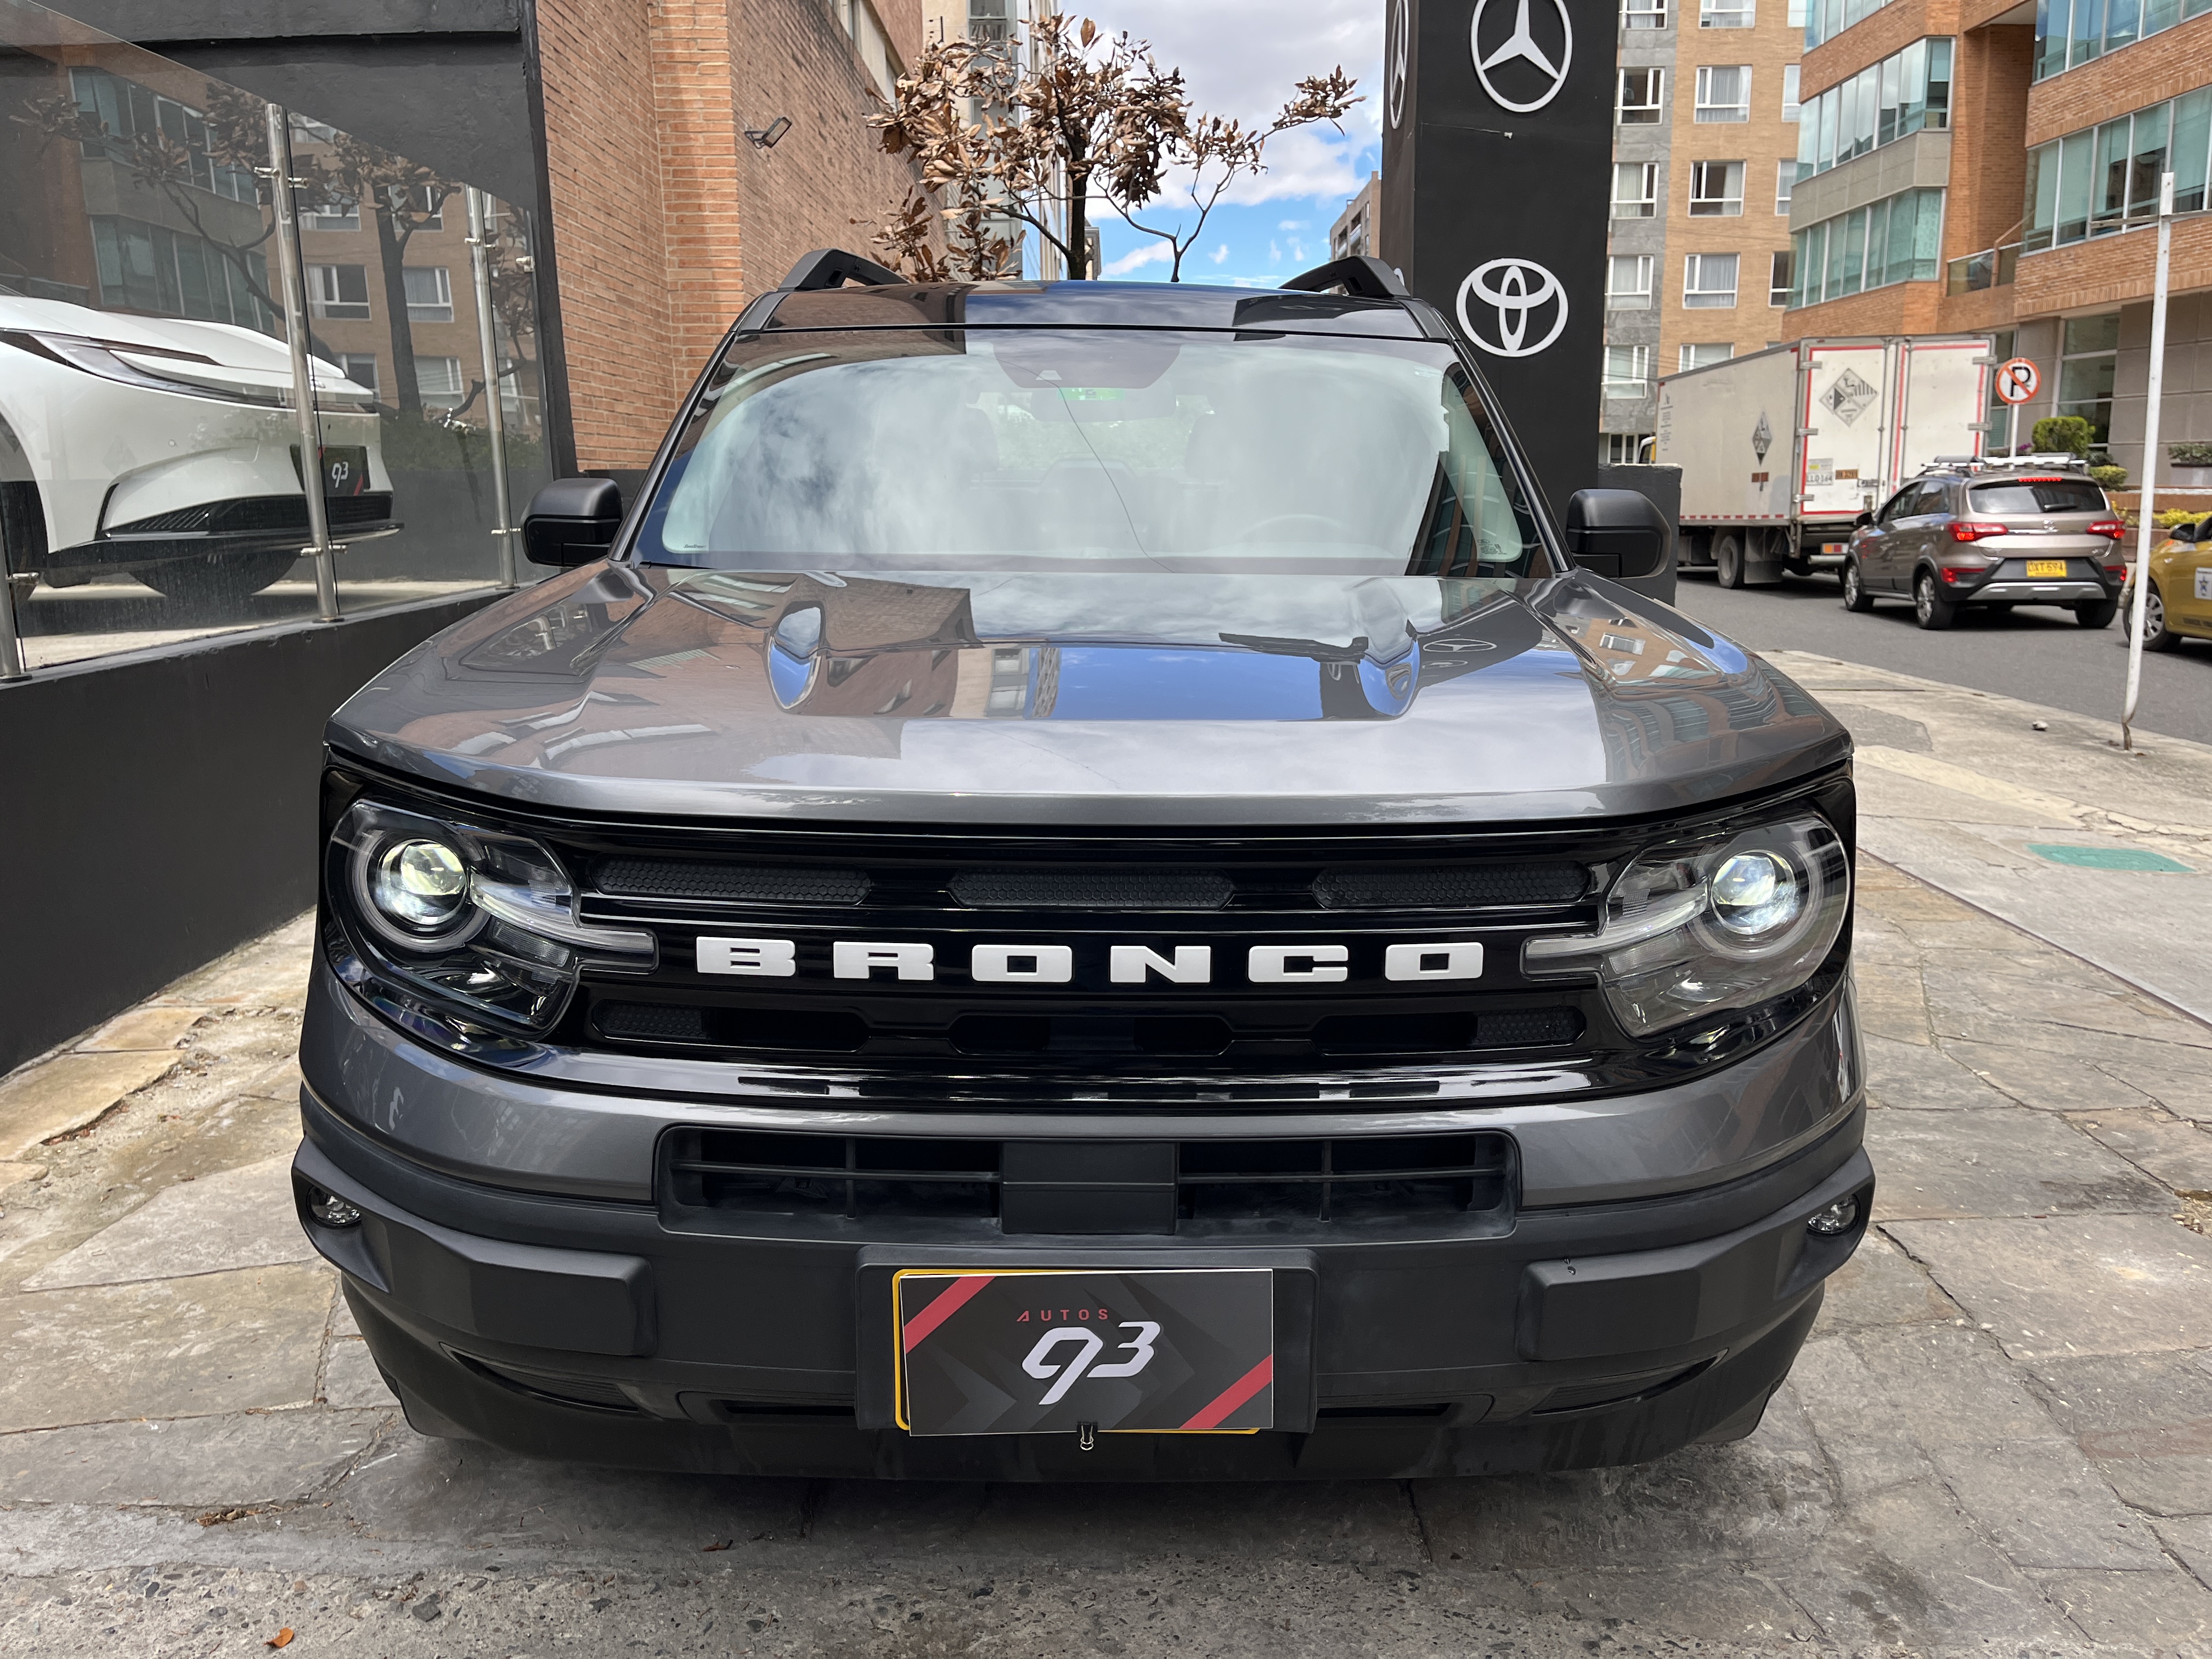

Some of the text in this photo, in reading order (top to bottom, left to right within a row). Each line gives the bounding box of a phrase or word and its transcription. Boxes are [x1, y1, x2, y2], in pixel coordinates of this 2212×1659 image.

[696, 936, 1483, 983] BRONCO
[1017, 1308, 1108, 1322] AUTOS
[1022, 1321, 1161, 1405] 93
